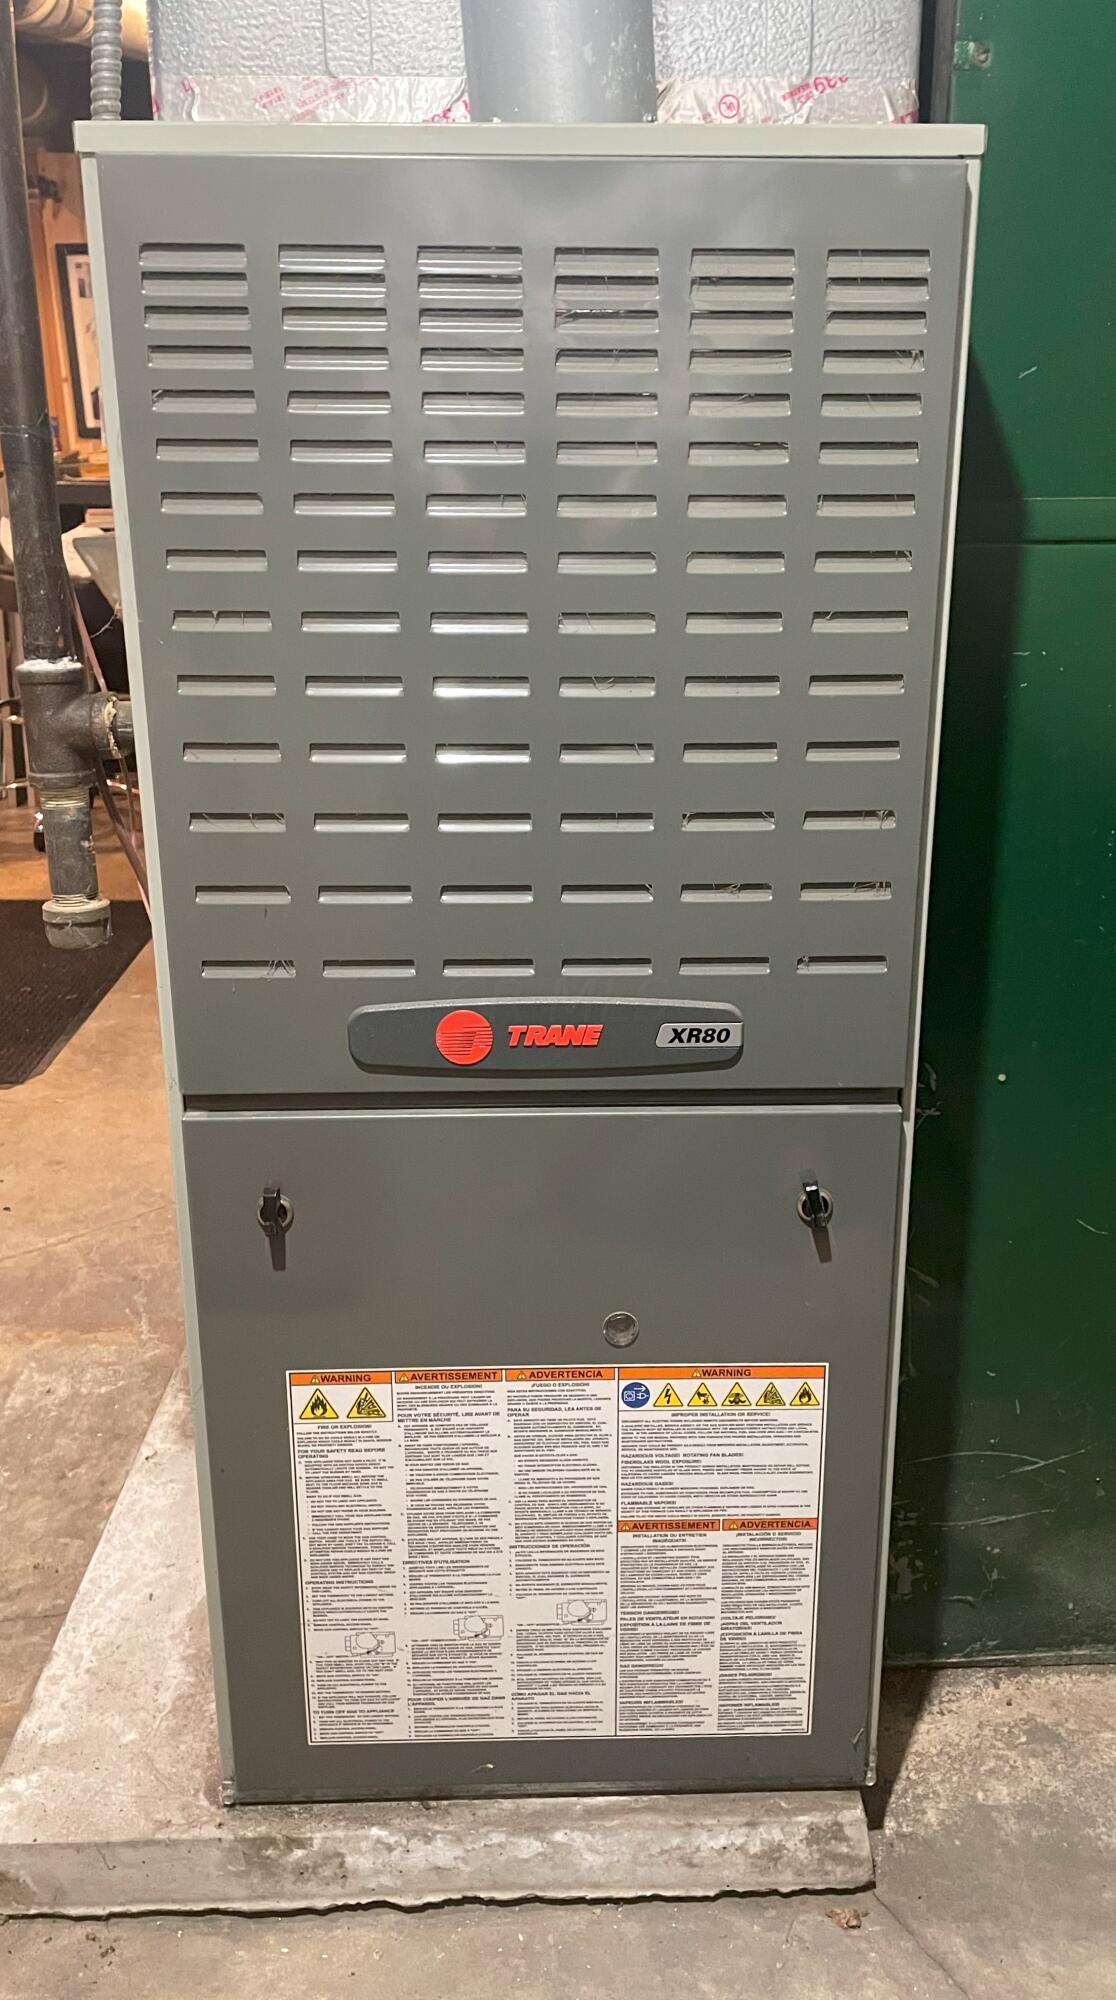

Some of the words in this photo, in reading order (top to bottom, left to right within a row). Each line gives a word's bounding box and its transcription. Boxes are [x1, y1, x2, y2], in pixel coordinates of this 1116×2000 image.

[508, 1025, 604, 1047] TRANE
[668, 1028, 731, 1044] XR80
[321, 1374, 371, 1382] WARNING
[411, 1372, 498, 1380] AVERTISSEMENT
